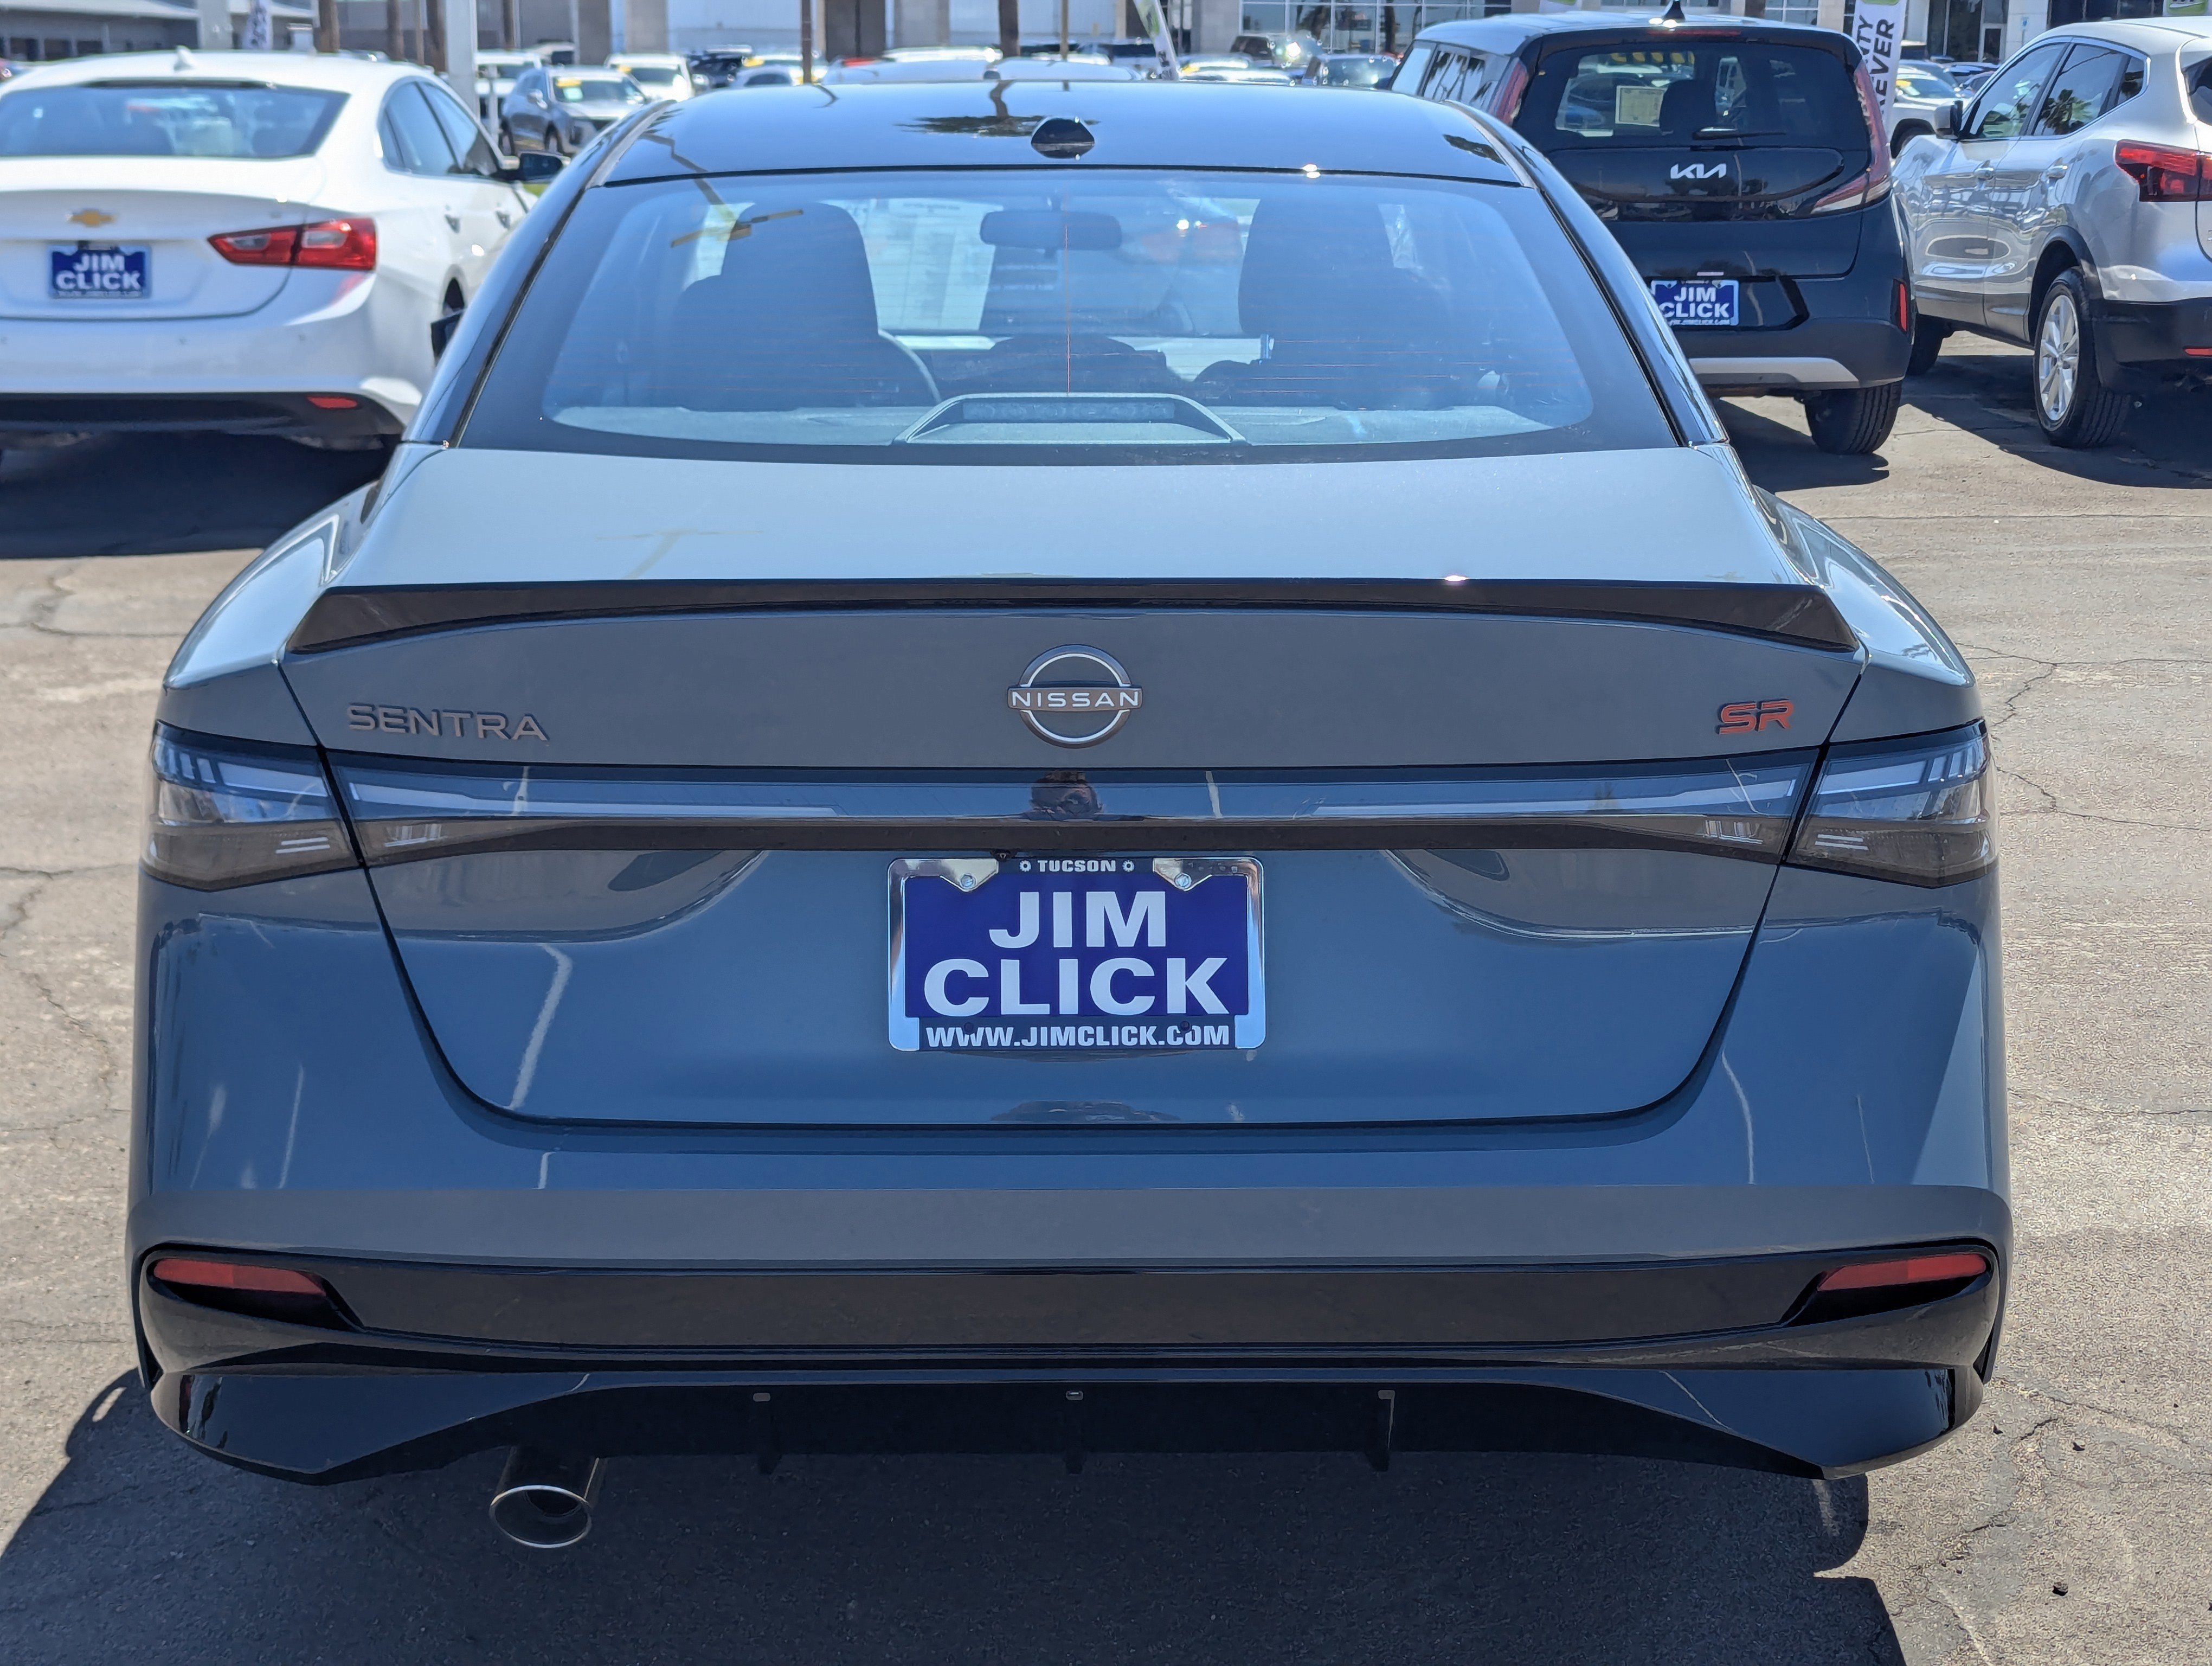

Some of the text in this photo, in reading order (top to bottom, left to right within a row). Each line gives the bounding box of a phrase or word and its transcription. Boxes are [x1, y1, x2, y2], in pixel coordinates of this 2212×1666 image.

[1670, 163, 1726, 179] KIA
[73, 253, 125, 271] JIM
[56, 270, 141, 290] CLICK
[1674, 287, 1716, 302] JIM
[1659, 302, 1729, 317] CLICK
[1012, 691, 1138, 707] NISSAN
[347, 703, 549, 741] SENTRA
[1718, 699, 1793, 735] SR
[1038, 860, 1116, 873] TUCSON
[989, 891, 1166, 949] JIM
[924, 957, 1230, 1017] CLICK
[926, 1025, 1229, 1047] WWW.JIMCLICK.COM
